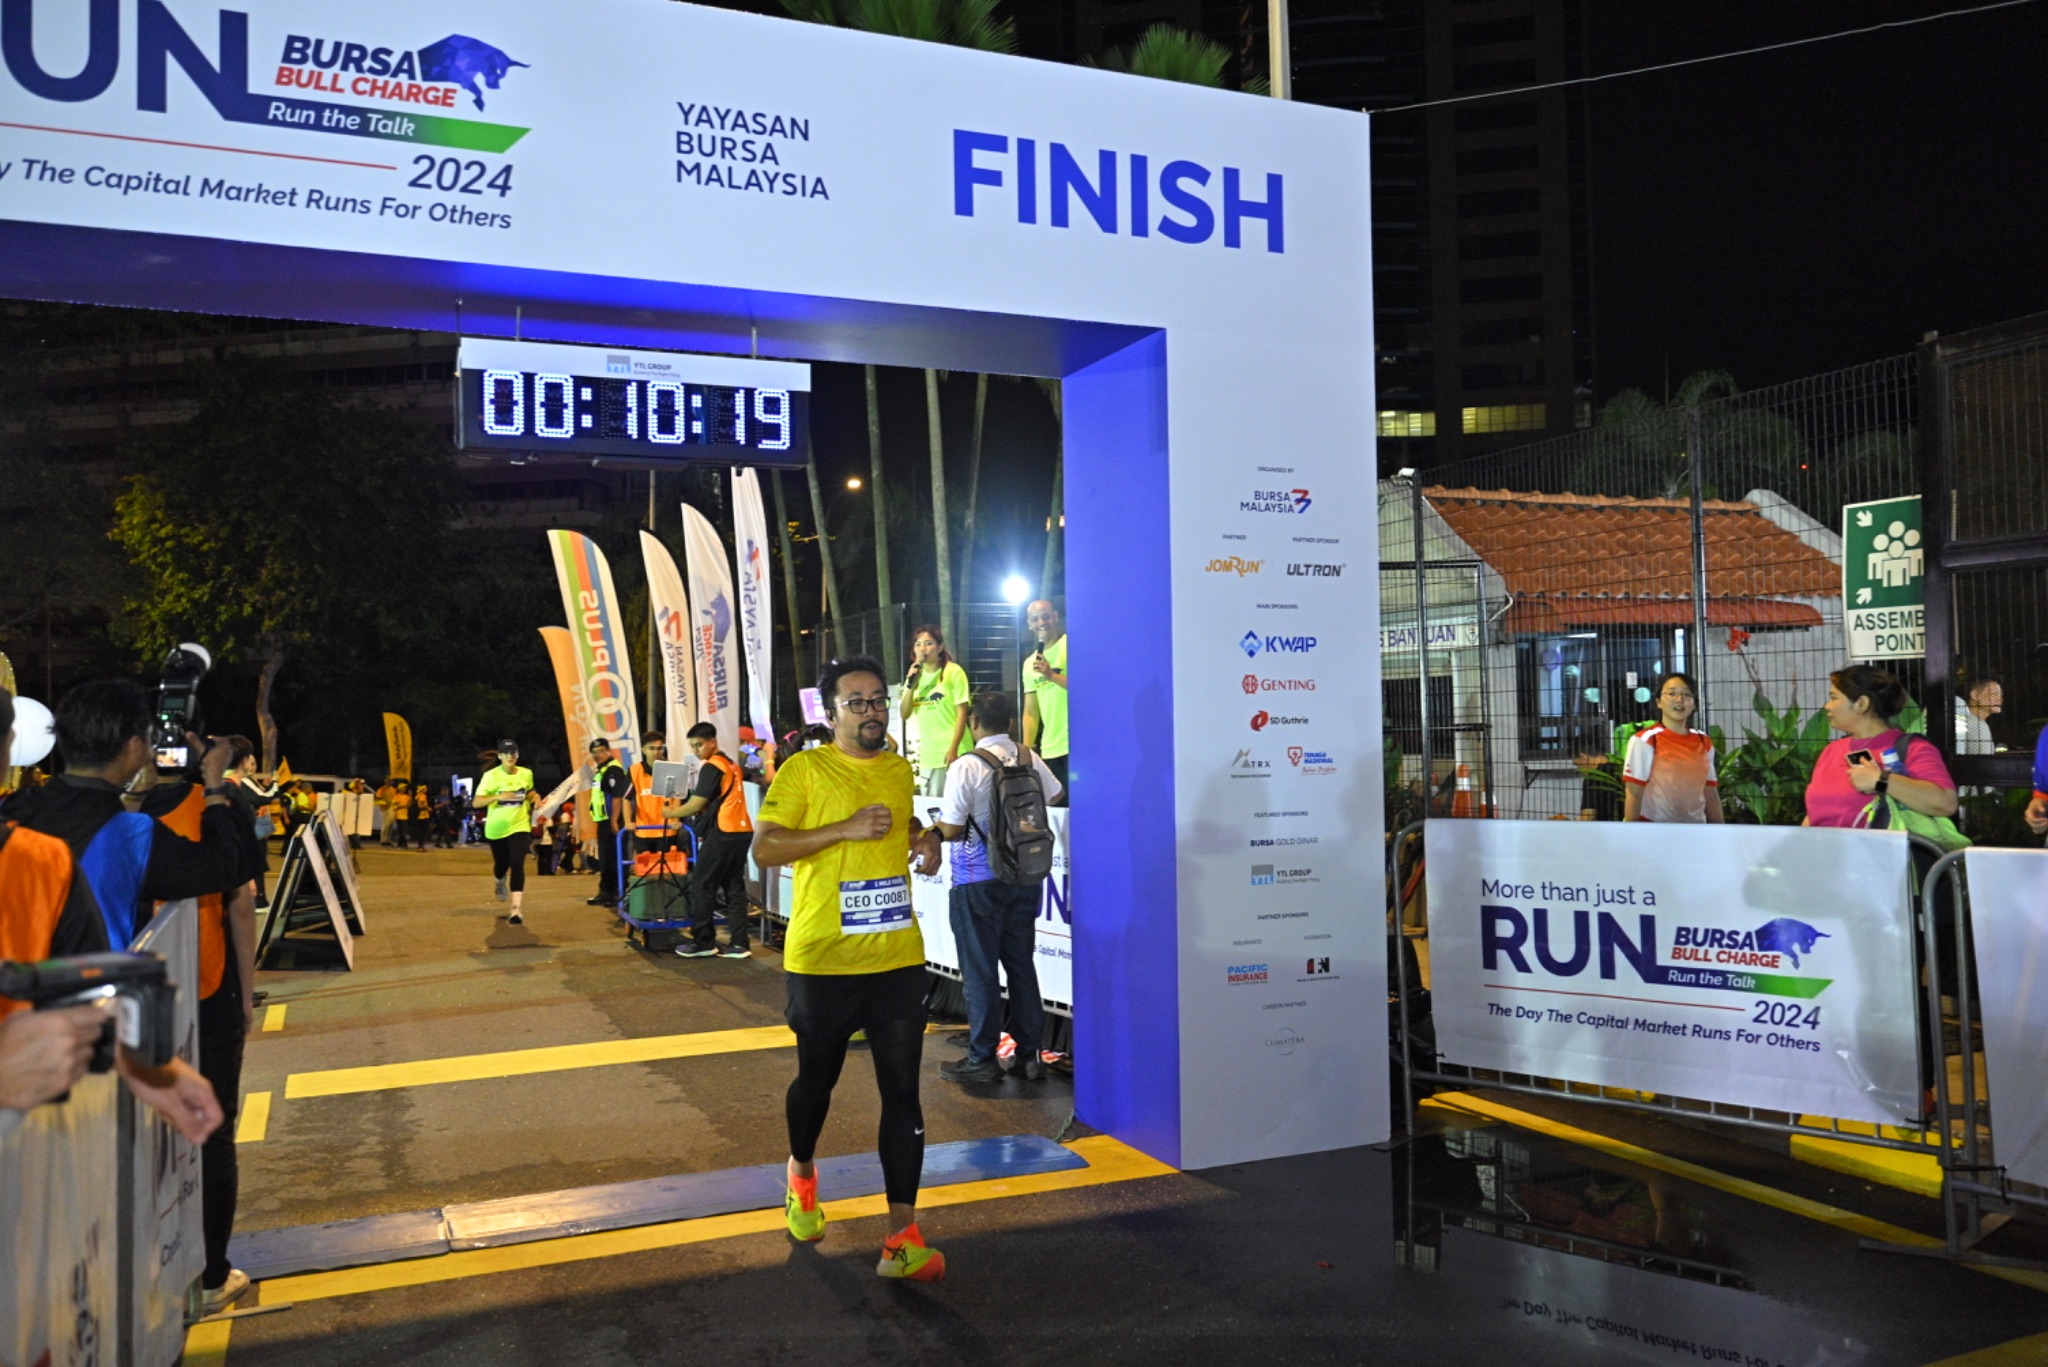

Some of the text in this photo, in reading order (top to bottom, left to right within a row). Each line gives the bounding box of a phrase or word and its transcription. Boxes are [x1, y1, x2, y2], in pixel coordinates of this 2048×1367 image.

[281, 34, 417, 81] BURSA
[275, 66, 456, 107] BULL CHARGE
[268, 103, 415, 137] Run the Talk
[676, 102, 810, 142] YAYASAN
[676, 130, 780, 166] BURSA
[408, 154, 513, 197] 2024
[676, 160, 830, 201] MALAYSIA
[21, 158, 75, 186] The
[84, 165, 191, 197] Capital
[199, 177, 297, 208] Market
[305, 189, 372, 216] Runs
[379, 197, 421, 221] For
[428, 202, 512, 229] Others
[953, 128, 1284, 254] FINISH
[483, 369, 790, 450] 00:10:19
[1240, 501, 1295, 514] MALAYSIA
[1254, 490, 1291, 502] BURSA
[1286, 563, 1341, 577] ULTRON
[1265, 636, 1317, 653] KWAP
[1389, 625, 1456, 647] BANUAN
[1875, 633, 1925, 652] POINT
[1261, 679, 1316, 691] GENTING
[1269, 716, 1309, 726] SD Guthrie
[1250, 837, 1318, 847] BURSA GOLD DINAR
[845, 895, 871, 908] CEO
[1481, 878, 1656, 907] More than just a
[1481, 905, 1657, 983] RUN
[1674, 926, 1755, 951] BURSA
[1228, 964, 1268, 974] PACIFIC
[1671, 947, 1781, 969] BULL CHARGE
[1668, 970, 1756, 989] Run the Talk
[1487, 1003, 1821, 1052] The Day The Capital Market Runs For Others
[1753, 1000, 1821, 1030] 2024
